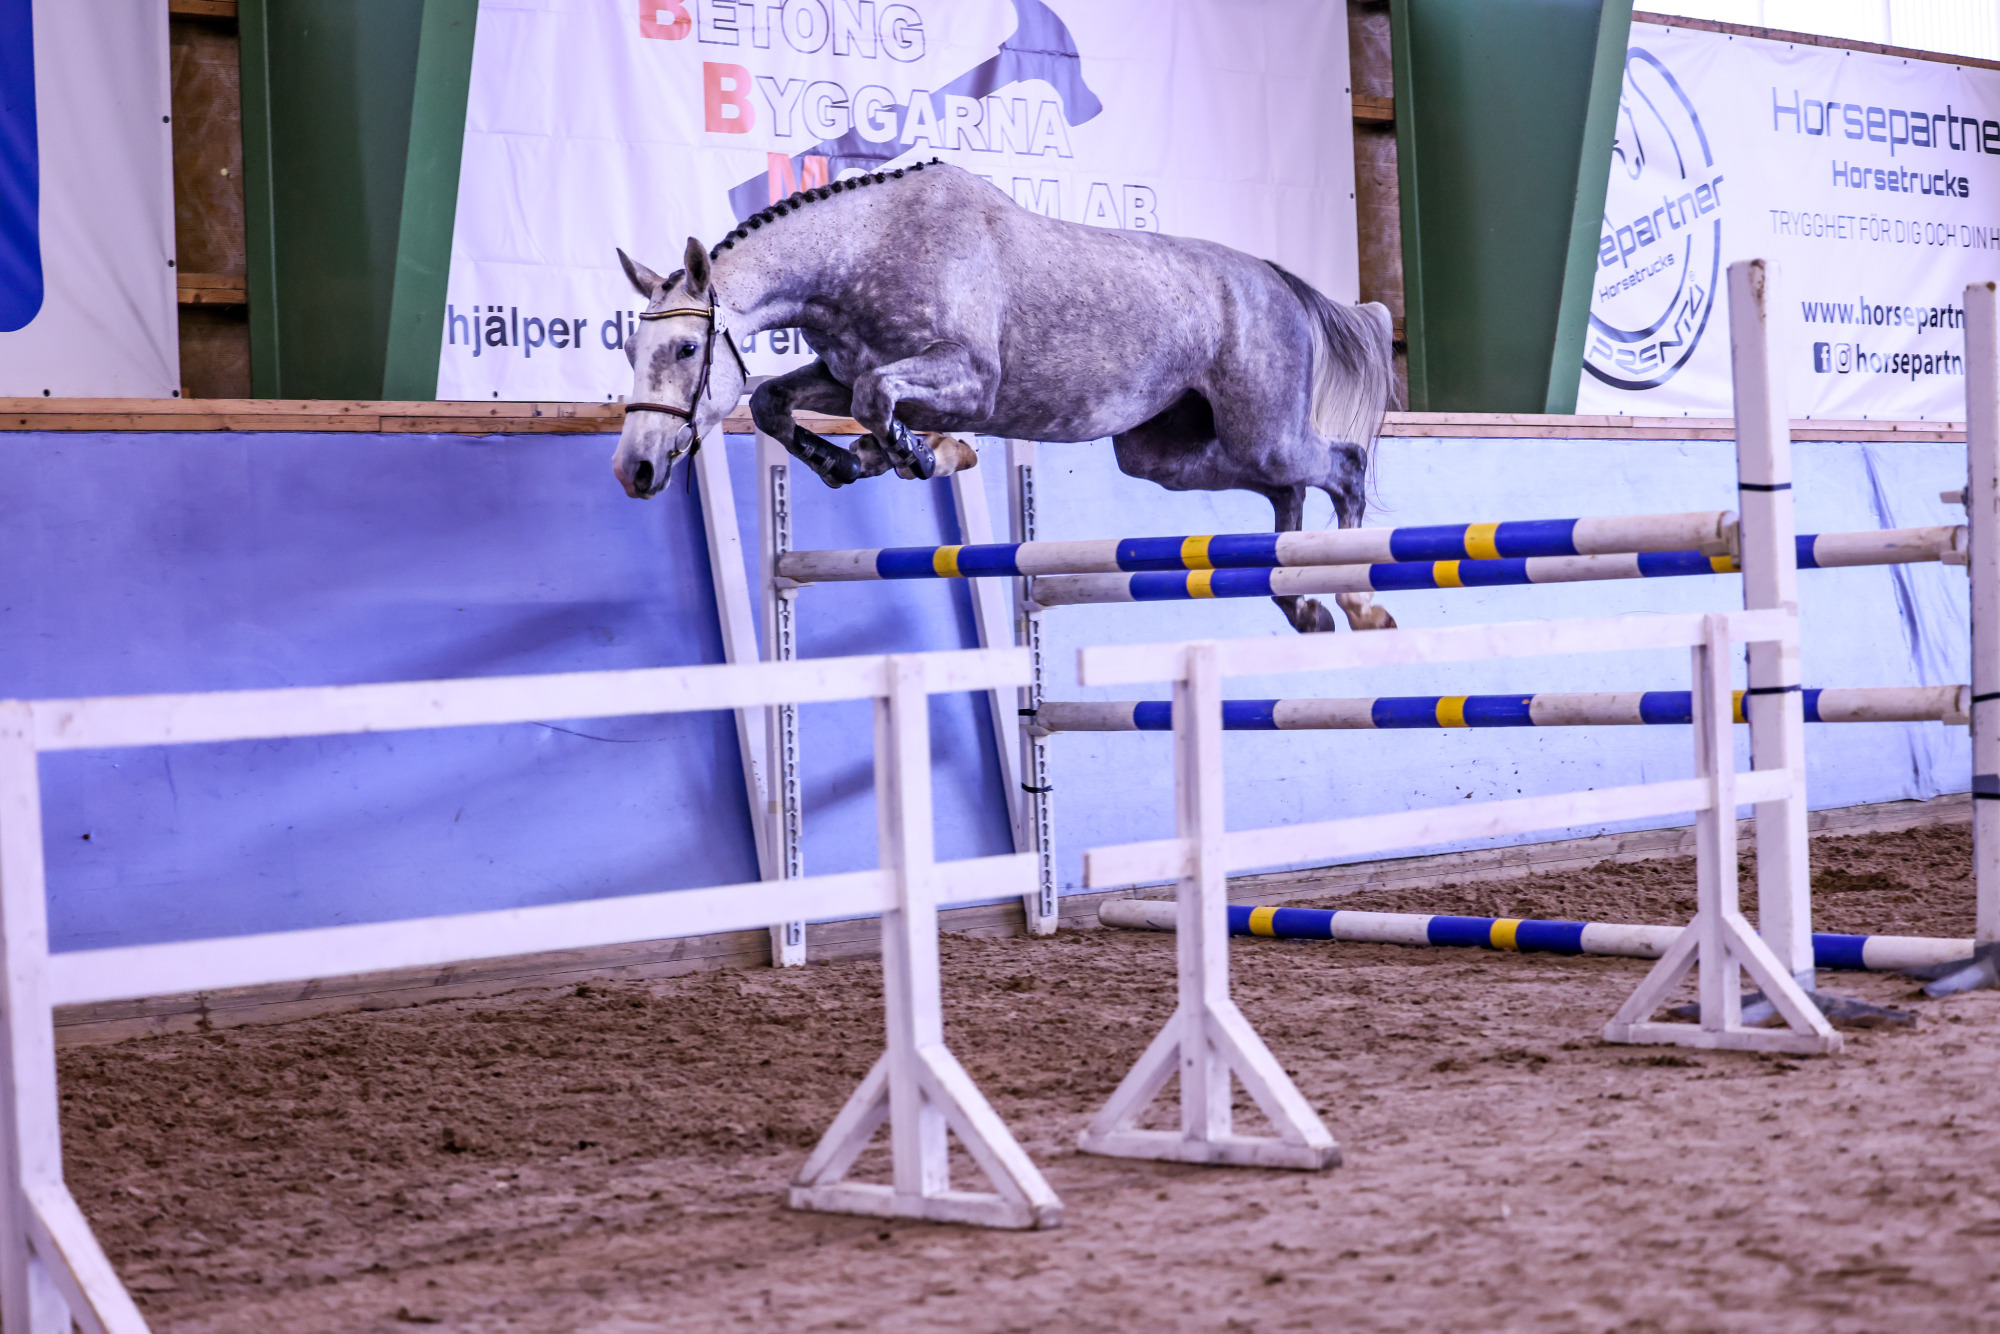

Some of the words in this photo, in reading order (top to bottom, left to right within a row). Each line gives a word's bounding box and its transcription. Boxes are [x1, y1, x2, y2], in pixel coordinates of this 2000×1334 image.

[639, 0, 926, 63] BETONG
[703, 61, 1074, 159] BYGGARNA
[1772, 87, 2000, 157] Horsepartne
[1832, 159, 1969, 198] Horsetrucks
[1082, 182, 1159, 233] AB
[1597, 175, 1724, 269] epartner
[1769, 209, 1856, 239] TRYGGHET
[1859, 213, 1891, 242] FÖR
[1895, 219, 1921, 244] DIG
[1925, 222, 1957, 247] OCH
[1961, 224, 1987, 249] DIN
[1599, 253, 1675, 303] Horsetrucks
[447, 303, 588, 358] hjälper
[601, 310, 635, 350] di
[1801, 295, 1965, 334] www.horsepartn
[1856, 343, 1965, 382] horsepartn
